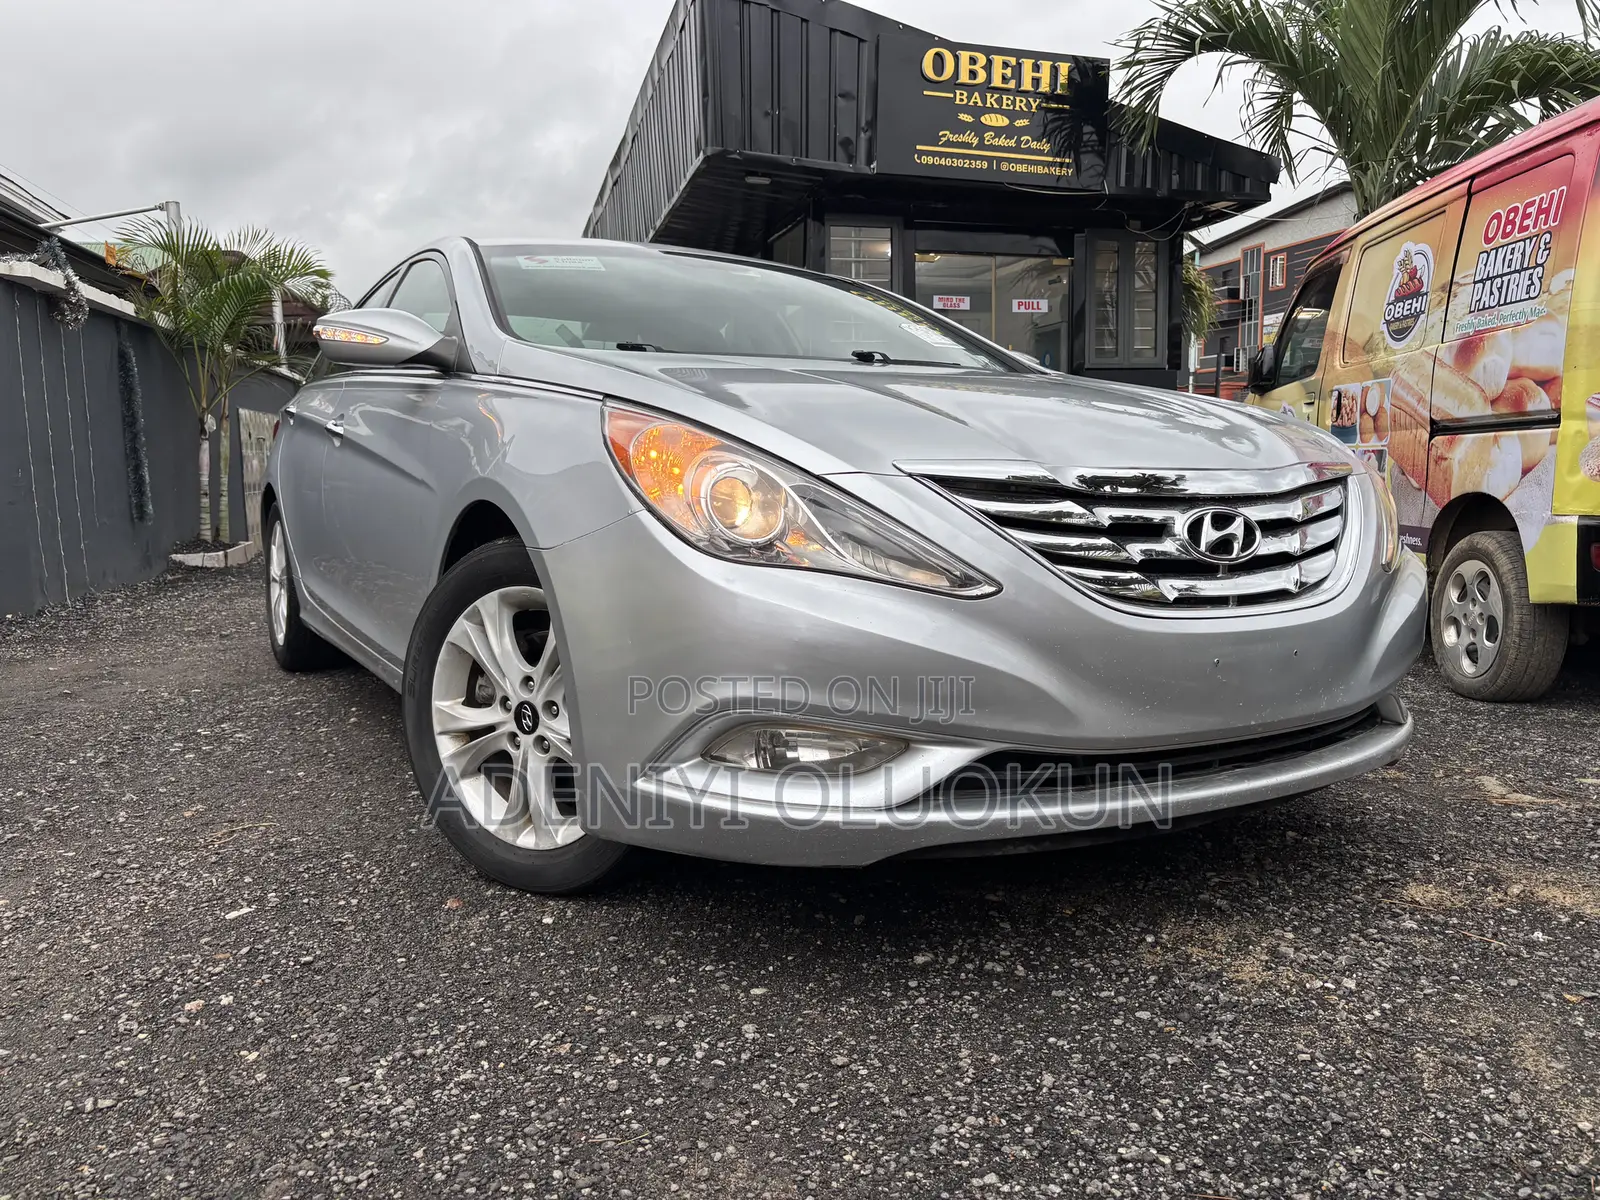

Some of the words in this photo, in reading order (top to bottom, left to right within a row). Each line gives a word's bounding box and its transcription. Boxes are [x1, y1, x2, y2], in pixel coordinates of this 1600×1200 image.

[922, 47, 1073, 95] OBEHI
[954, 89, 1041, 112] BAKERY
[938, 130, 979, 147] Freshly
[984, 132, 1017, 148] Baked
[1020, 135, 1050, 153] Daily
[921, 154, 988, 169] 09040302359
[1482, 186, 1566, 247] OBEHI
[1473, 234, 1539, 282] BAKERY
[1536, 231, 1552, 265] &
[1469, 266, 1544, 313] PASTRIES
[1017, 301, 1042, 311] PULL
[1384, 295, 1427, 321] OBEHI
[1455, 317, 1475, 334] Freshly
[1499, 307, 1528, 325] Perfectly
